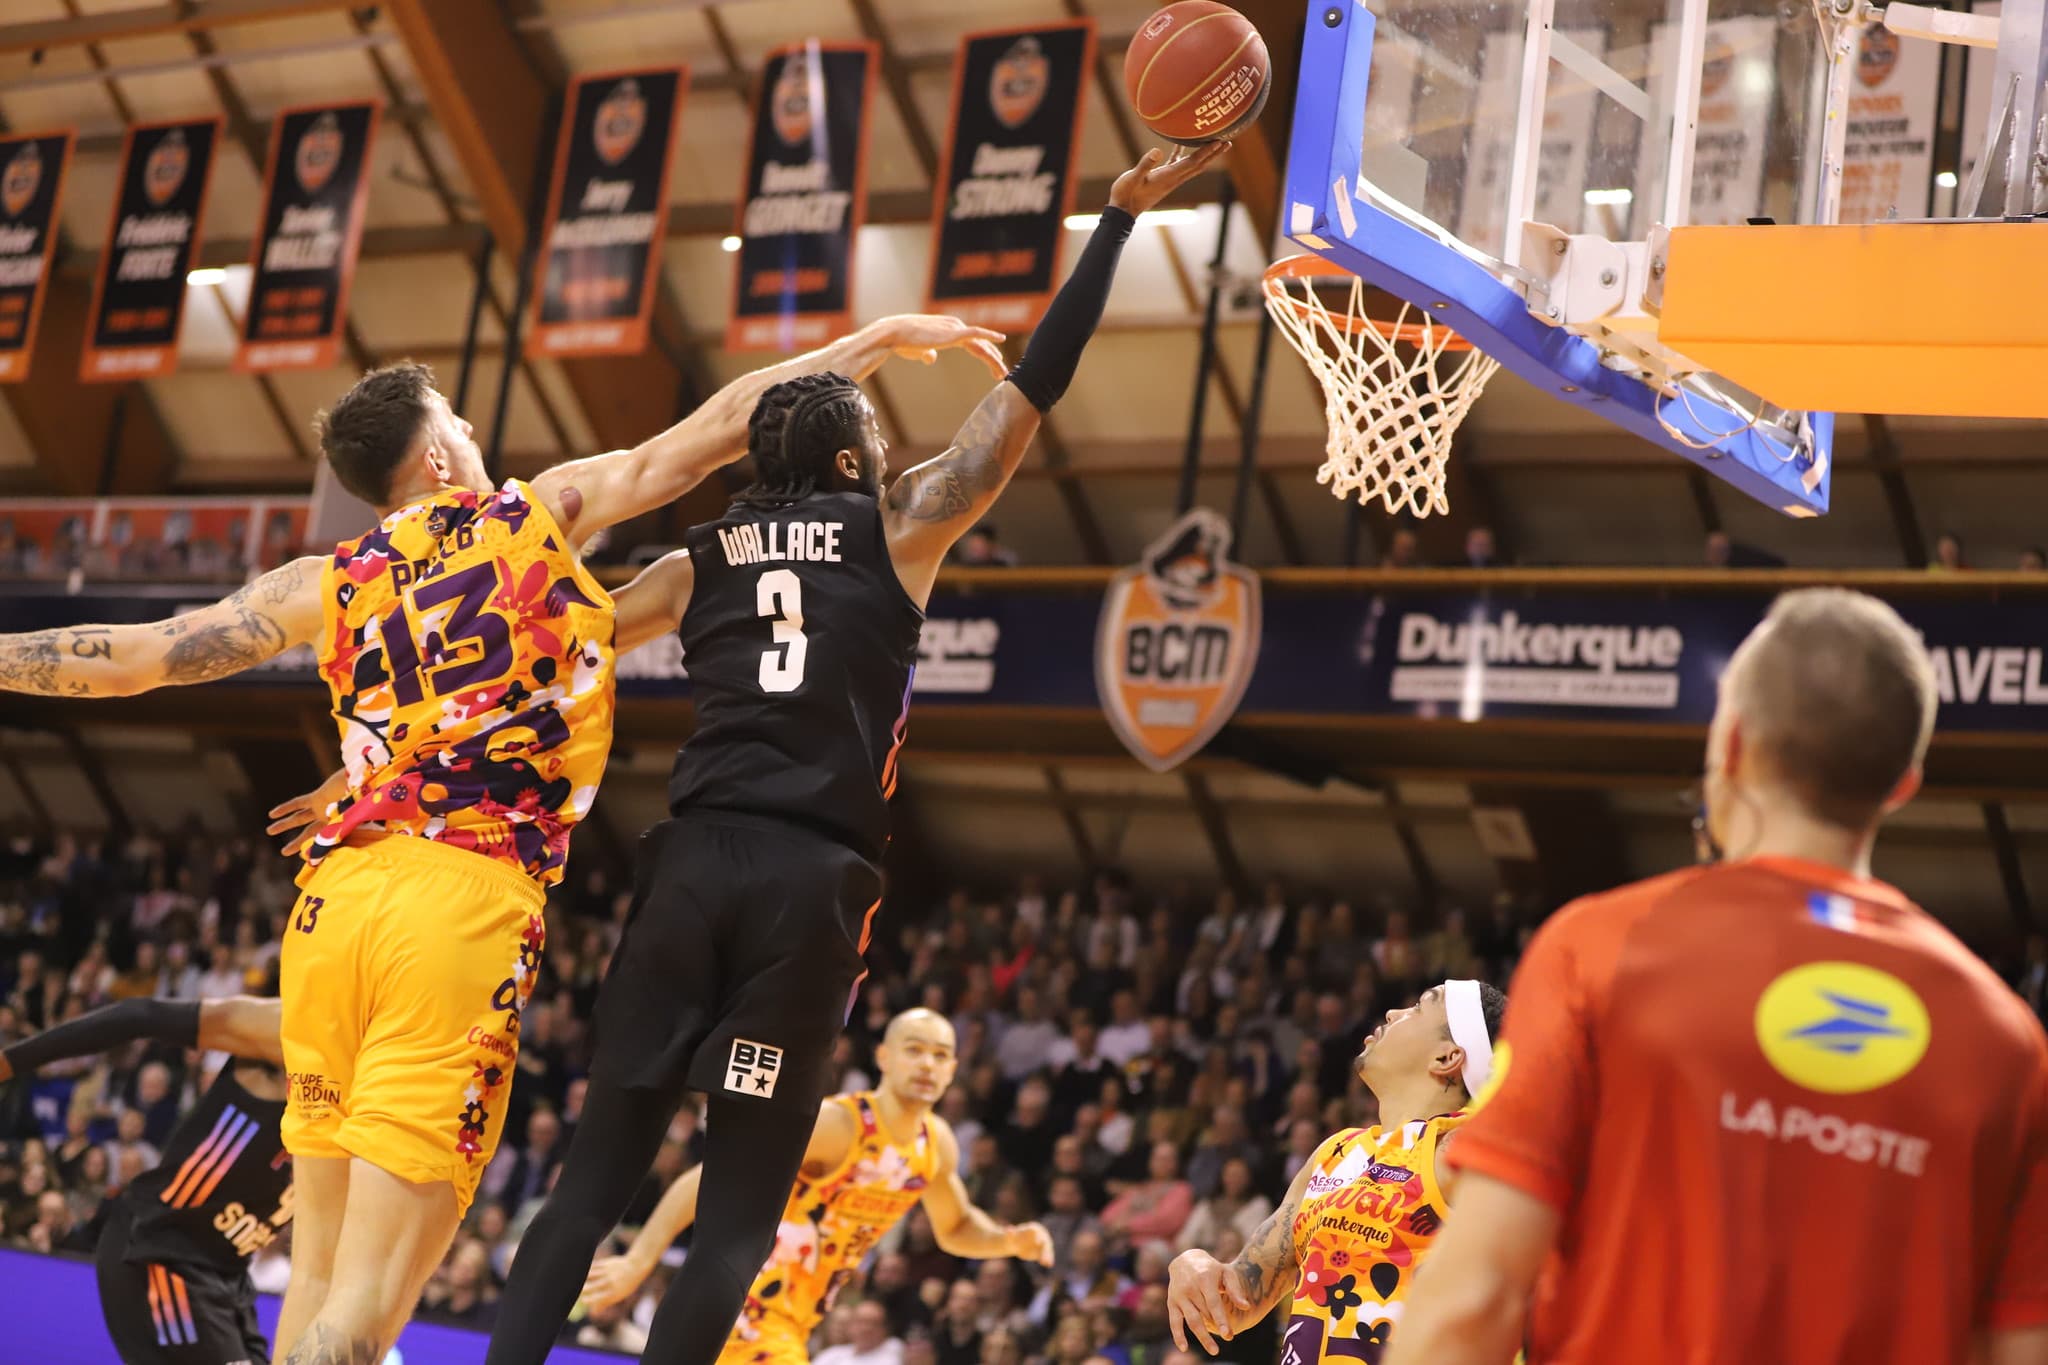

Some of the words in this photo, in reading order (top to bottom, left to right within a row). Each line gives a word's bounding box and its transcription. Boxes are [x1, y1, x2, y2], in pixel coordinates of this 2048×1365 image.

[1195, 66, 1260, 130] LEGACY
[951, 172, 1056, 219] STRONG
[718, 521, 844, 567] WALLACE
[70, 628, 112, 660] 13
[380, 560, 514, 708] 13
[756, 568, 808, 693] 3
[1127, 623, 1231, 681] BCM
[1398, 611, 1684, 674] Dunkerque
[296, 895, 325, 934] 13
[1720, 1092, 1777, 1139] LA
[1780, 1106, 1931, 1177] POSTE
